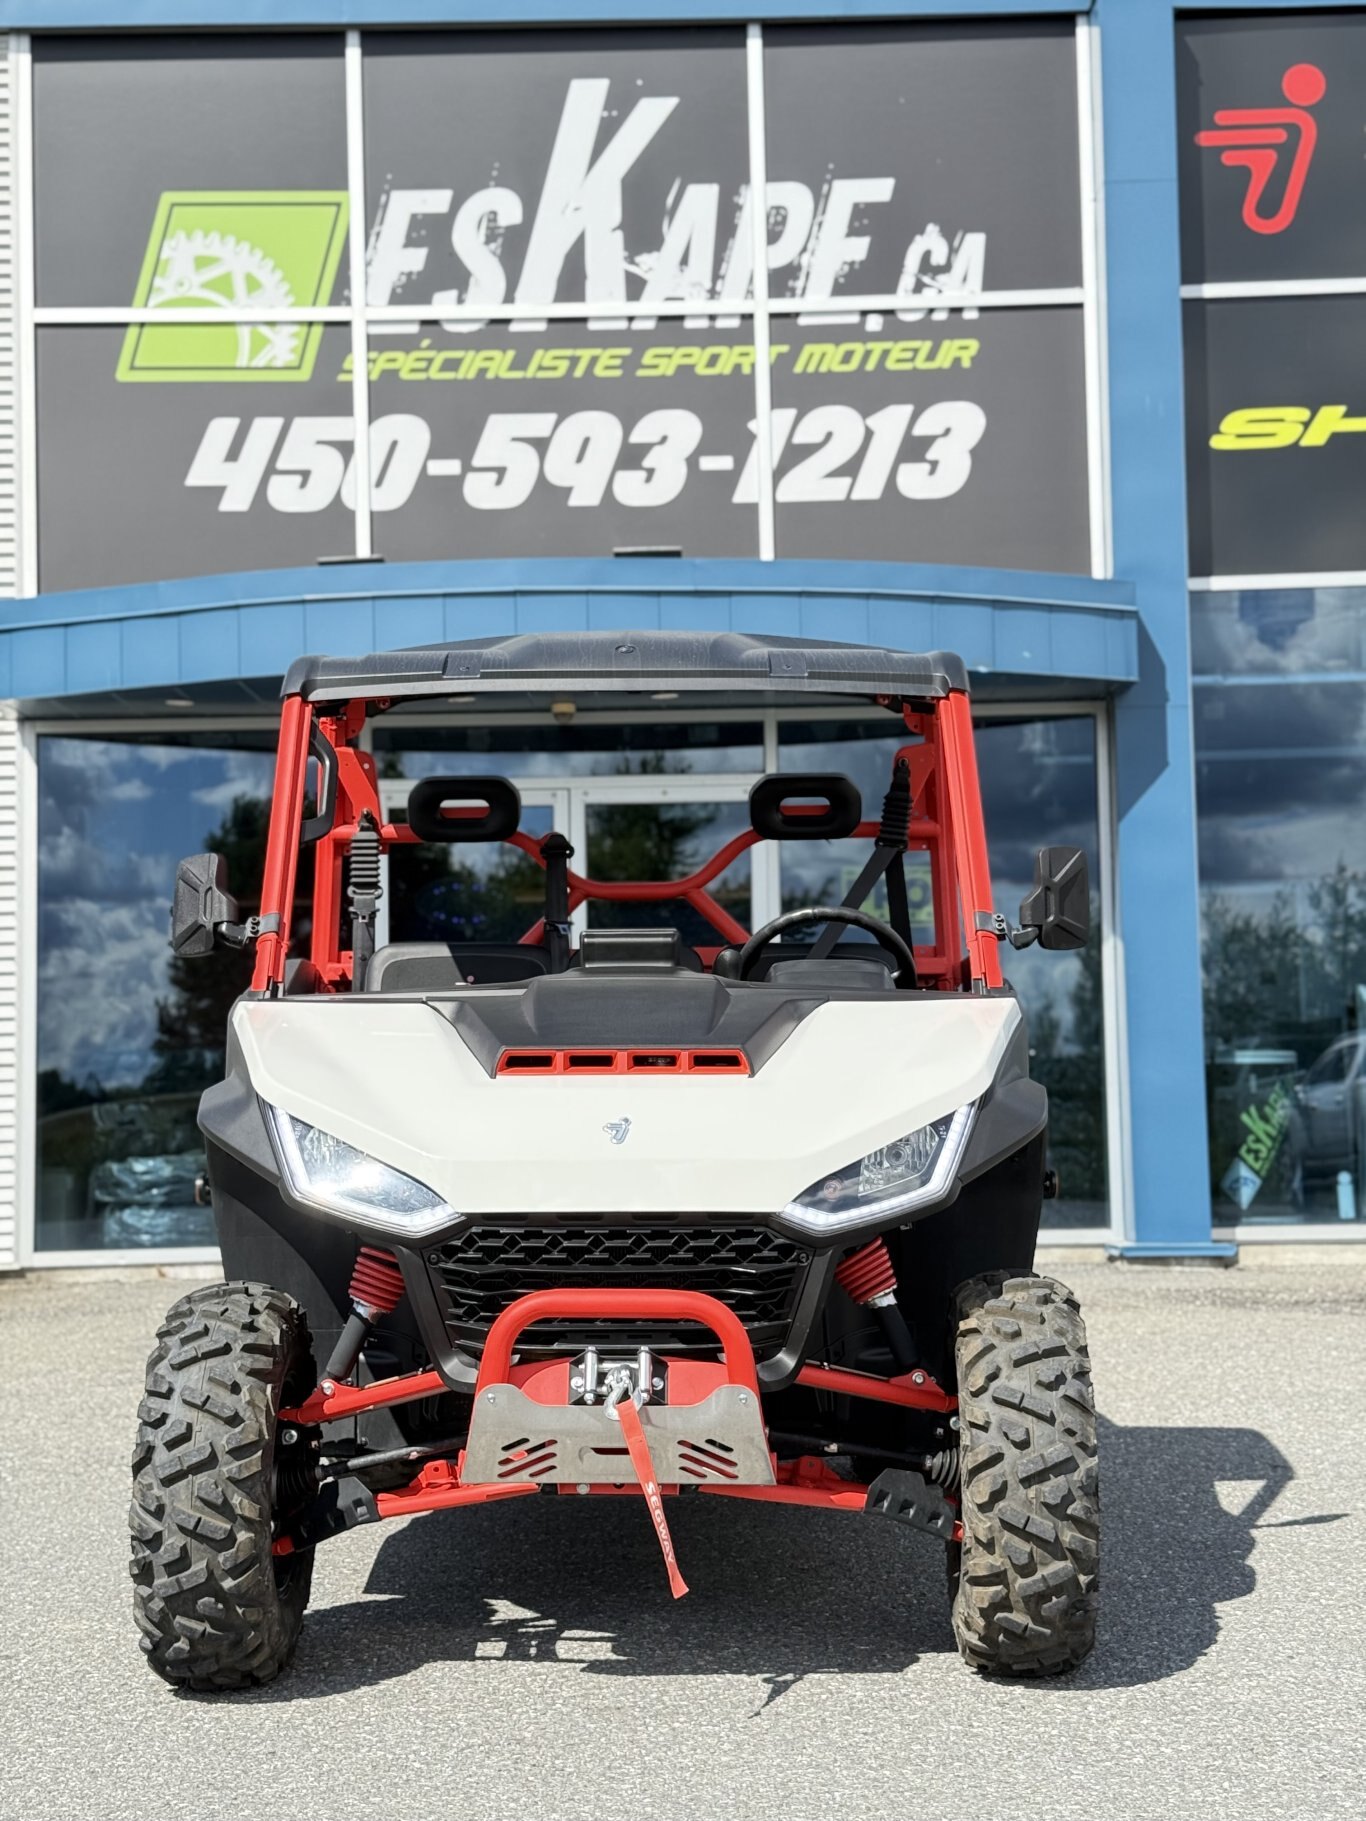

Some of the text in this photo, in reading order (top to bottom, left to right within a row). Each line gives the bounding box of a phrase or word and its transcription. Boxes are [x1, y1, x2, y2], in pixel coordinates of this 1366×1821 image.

[793, 338, 980, 374] MOTEUR
[184, 401, 987, 513] 450-593-1213
[644, 1480, 676, 1563] SEGWAY
